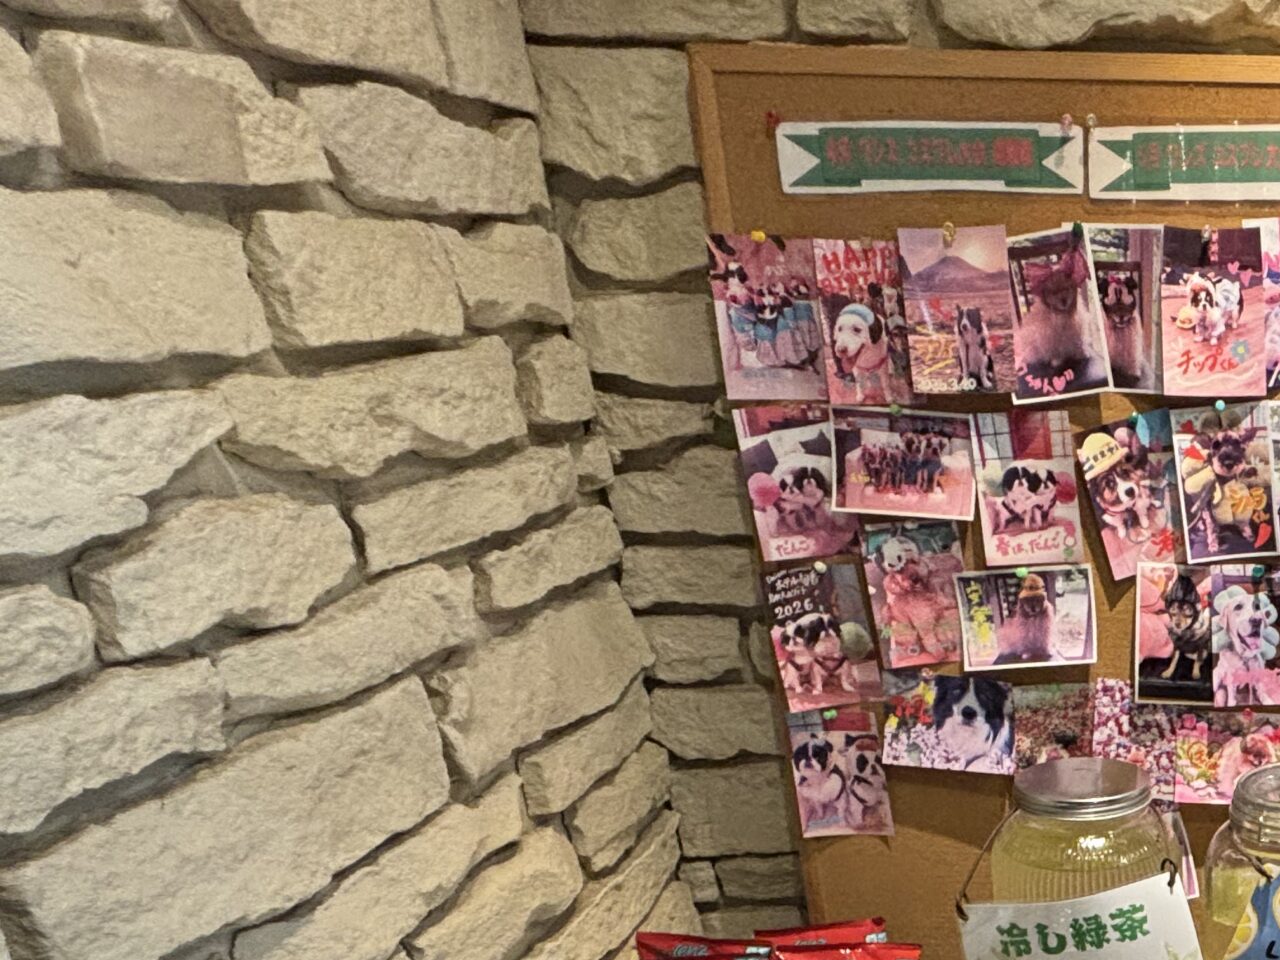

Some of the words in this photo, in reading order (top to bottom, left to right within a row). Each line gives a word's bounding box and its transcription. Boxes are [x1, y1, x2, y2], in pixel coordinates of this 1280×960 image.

[822, 246, 895, 274] HAPP
[774, 597, 814, 620] 2026
[996, 904, 1150, 957] 冷し緑茶
